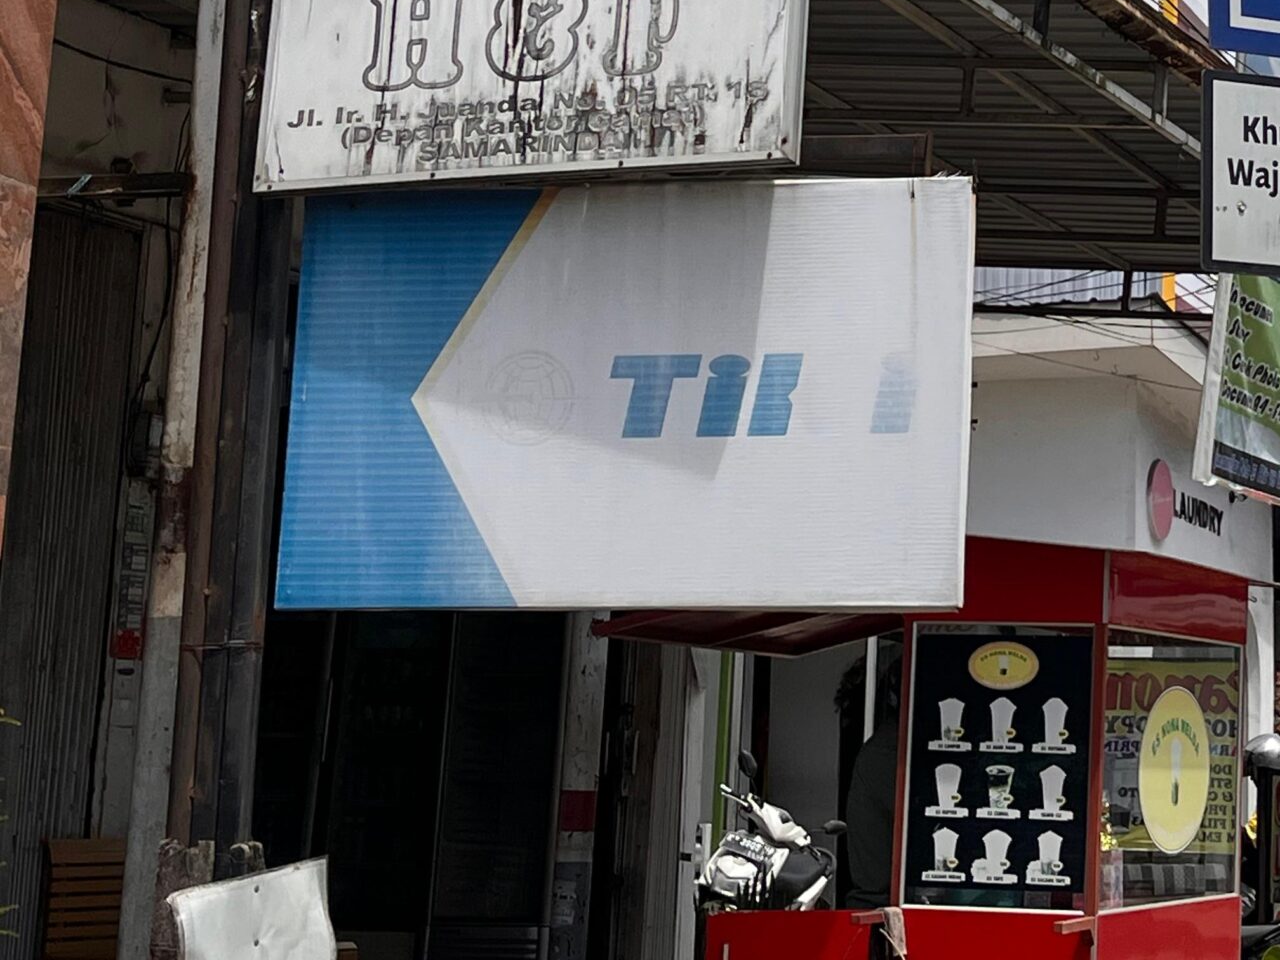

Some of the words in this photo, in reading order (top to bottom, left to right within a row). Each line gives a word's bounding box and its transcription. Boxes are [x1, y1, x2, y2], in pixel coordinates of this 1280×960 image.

[287, 108, 324, 129] Jl.
[334, 105, 363, 126] Ir.
[419, 95, 538, 121] Juanda
[341, 117, 459, 149] (Depan
[418, 131, 623, 162] SAMARINDA
[1173, 488, 1224, 536] LAUNDRY
